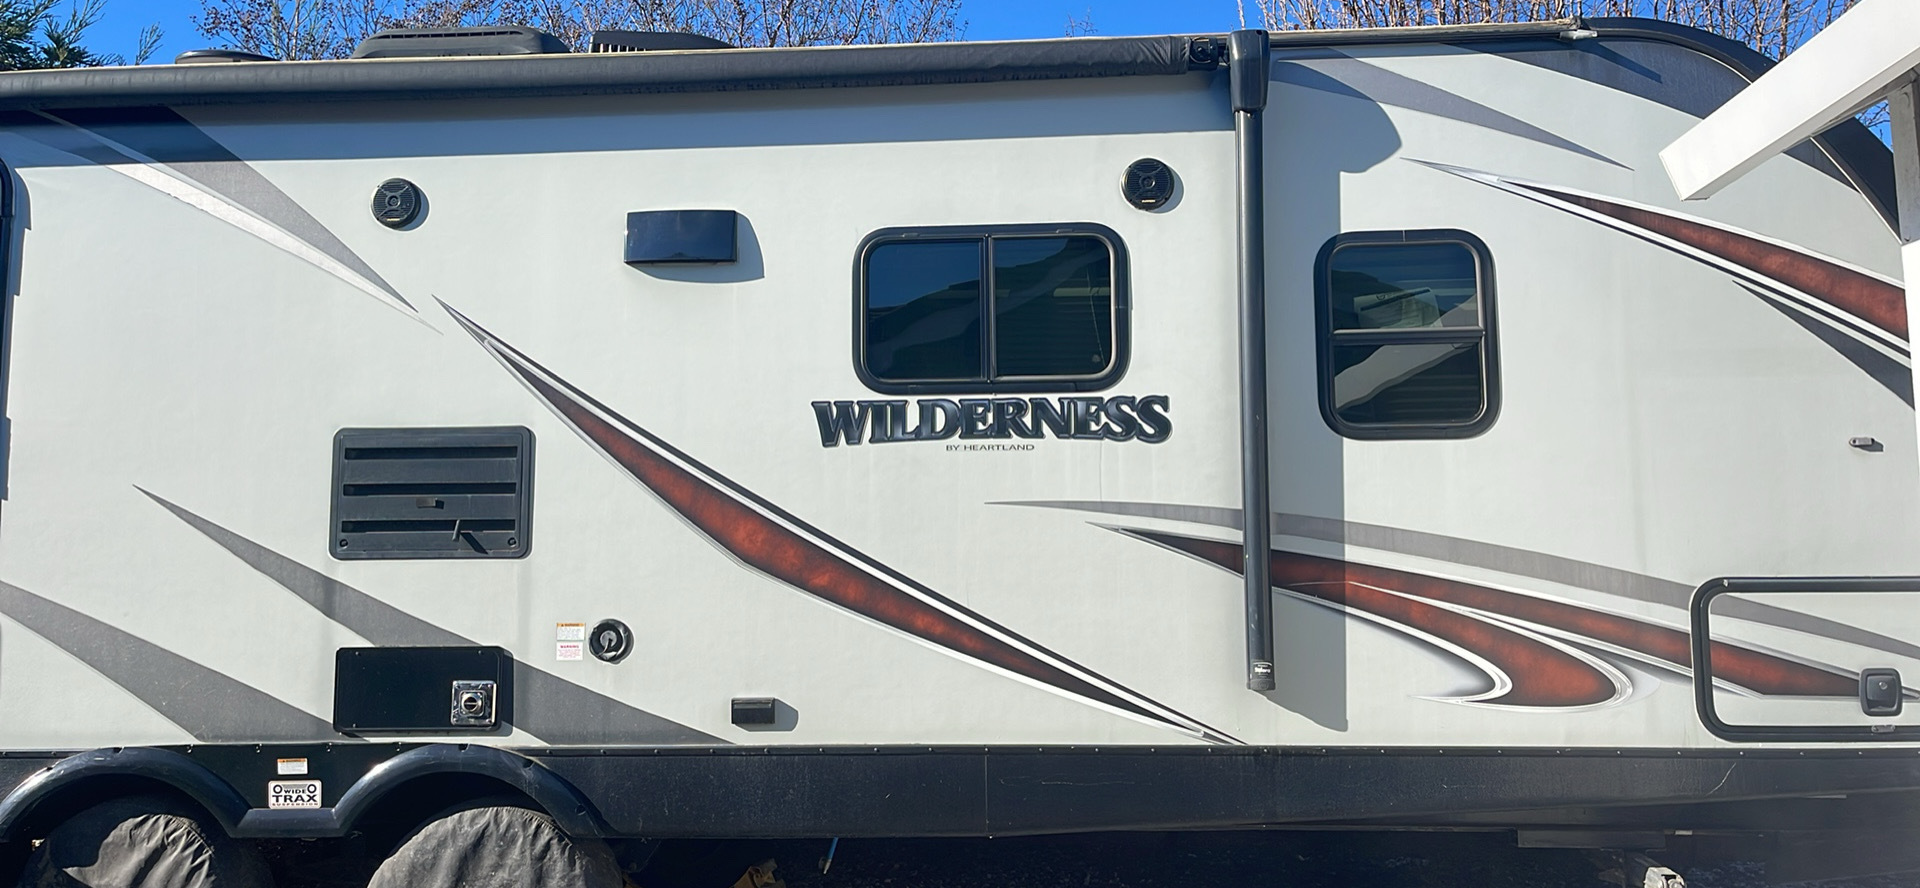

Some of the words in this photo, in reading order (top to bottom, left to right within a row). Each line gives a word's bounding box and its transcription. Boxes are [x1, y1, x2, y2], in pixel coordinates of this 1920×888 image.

[811, 395, 1172, 448] WILDERNESS
[964, 443, 1035, 451] HEARTLAND
[272, 795, 318, 803] TRAX
